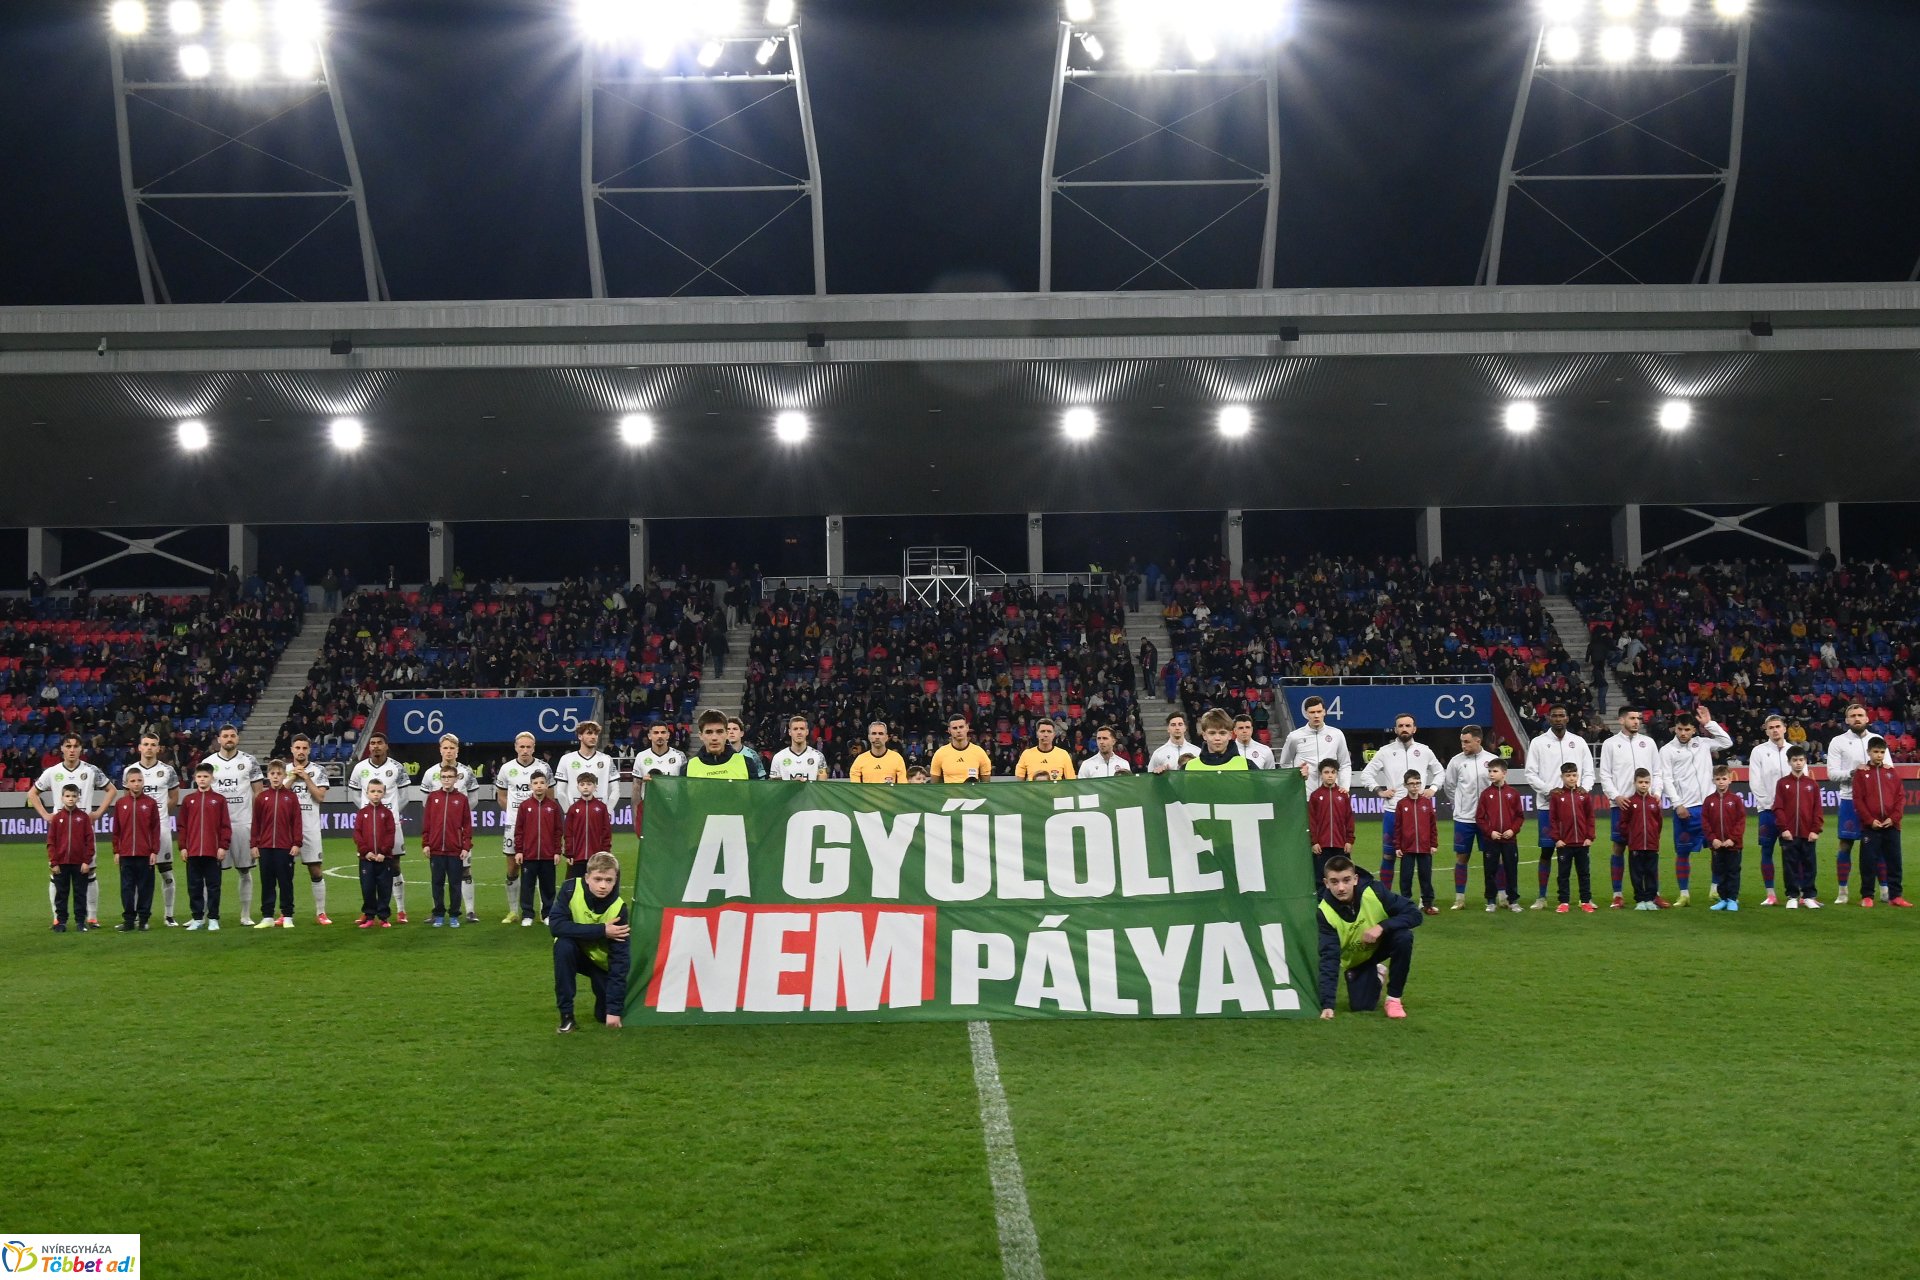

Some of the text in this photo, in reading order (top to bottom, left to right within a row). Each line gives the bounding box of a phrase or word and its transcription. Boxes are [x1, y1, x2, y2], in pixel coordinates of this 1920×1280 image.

[538, 707, 579, 733] C5
[1434, 694, 1476, 720] C3
[403, 709, 445, 735] C6
[706, 769, 729, 777] macron
[0, 817, 48, 835] TAGJA!
[482, 811, 496, 827] IS
[682, 793, 1276, 903] A GYŰLÖLET
[656, 909, 1301, 1016] NEM PÁLYA!
